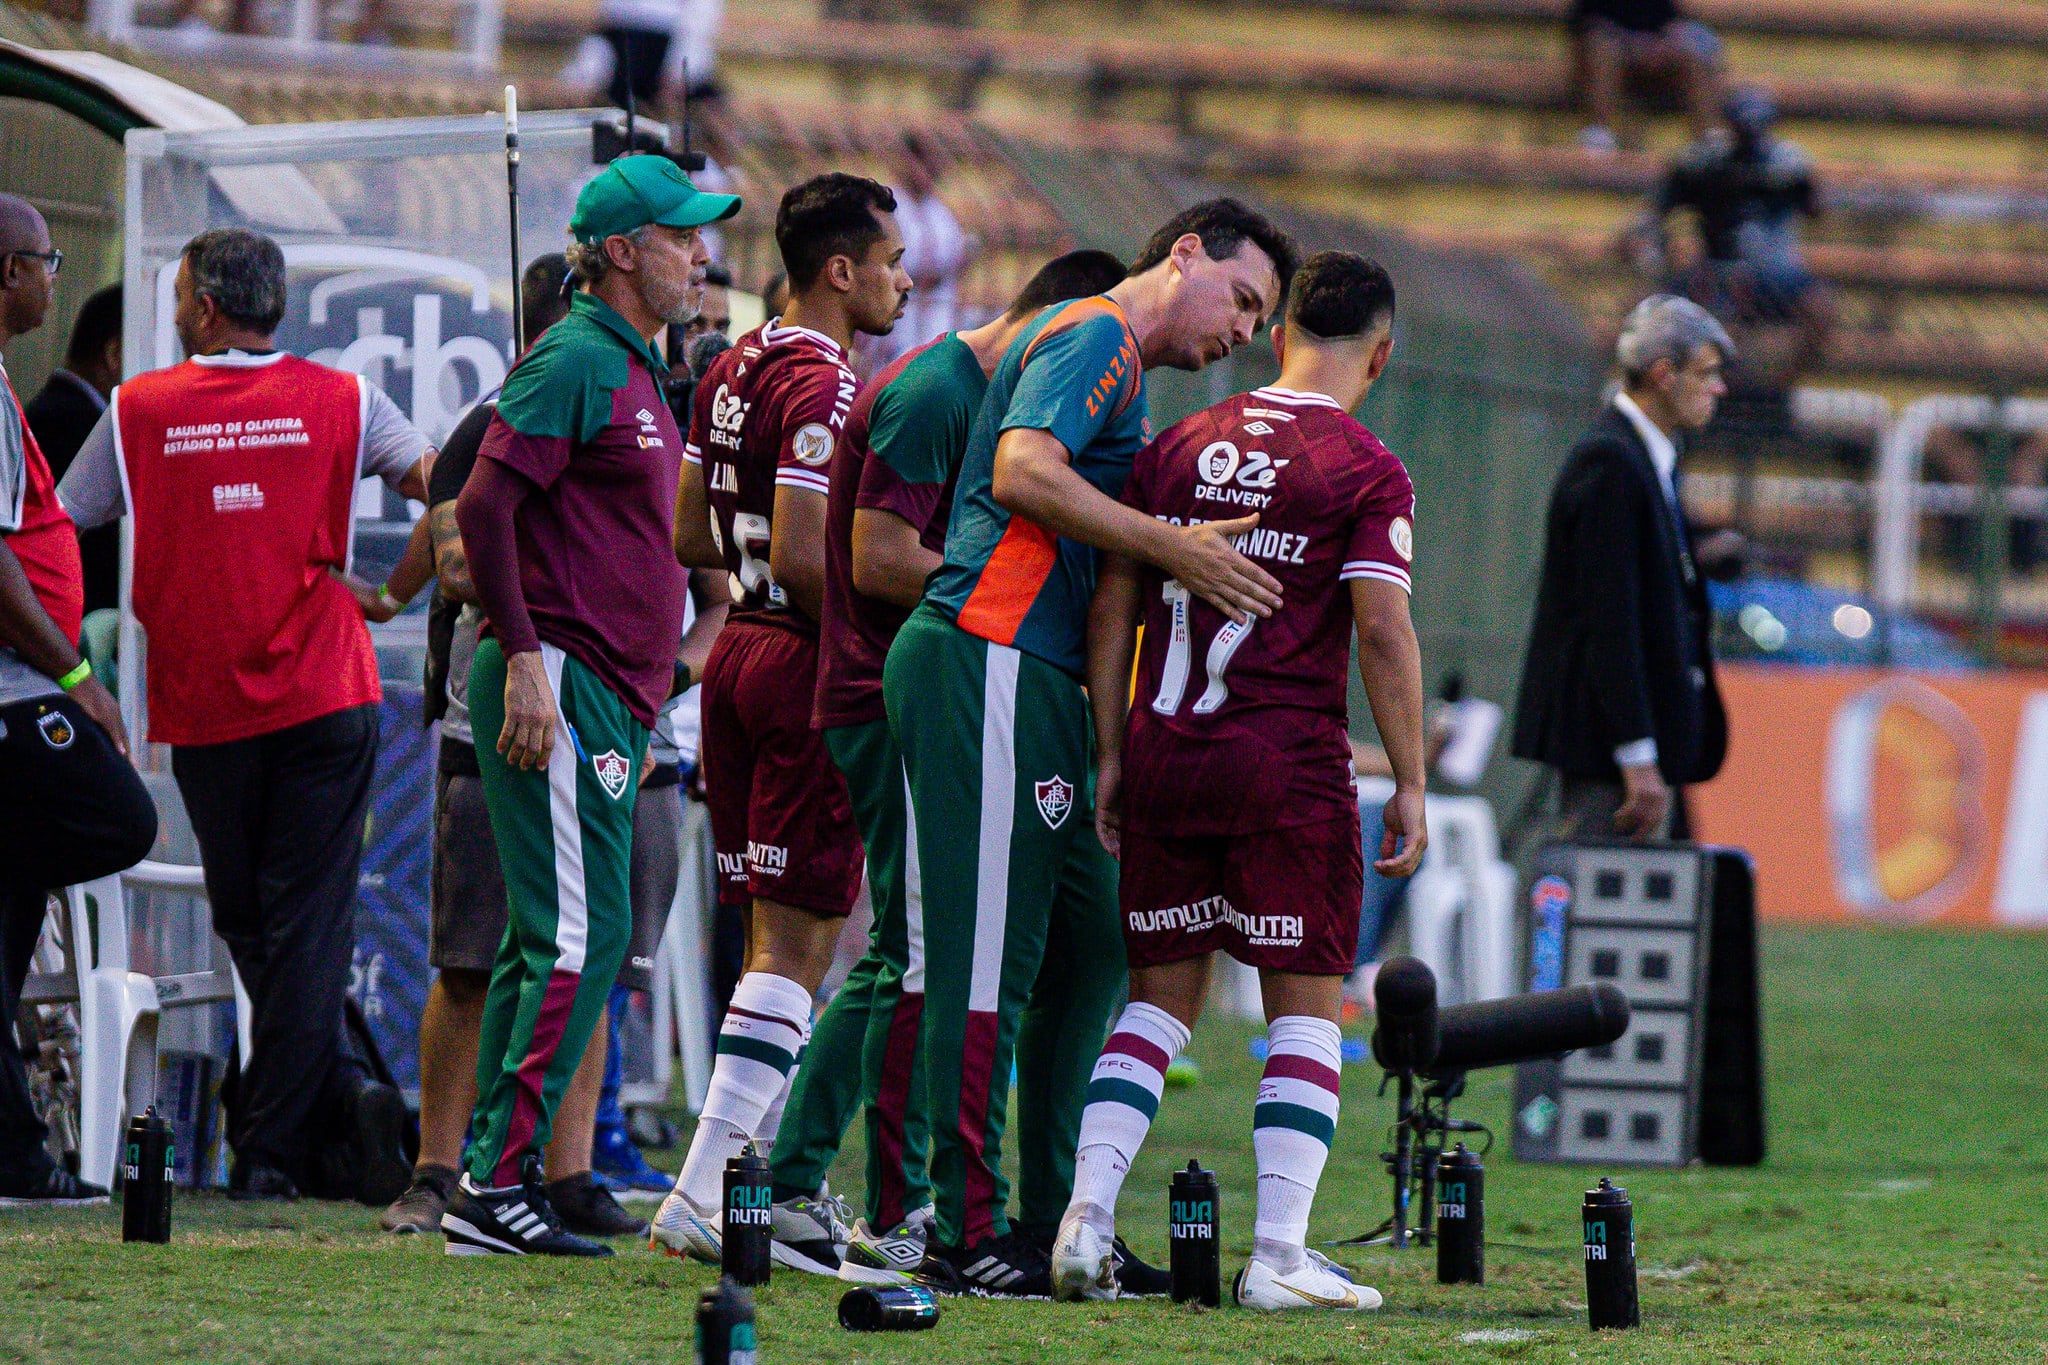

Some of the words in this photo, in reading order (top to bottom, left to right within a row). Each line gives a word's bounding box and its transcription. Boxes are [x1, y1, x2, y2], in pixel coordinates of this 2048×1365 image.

[166, 423, 223, 439] RAULINO
[225, 421, 242, 434] DE
[245, 417, 303, 432] OLIVEIRA
[216, 436, 236, 449] DA
[238, 432, 309, 448] CIDADANIA
[212, 482, 264, 499] SMEL
[1194, 484, 1272, 508] DELIVERY
[1175, 601, 1184, 626] TIM
[1249, 937, 1303, 948] RECOVERY
[1098, 1060, 1133, 1071] FFC
[729, 1208, 771, 1225] NUTRI
[1170, 1223, 1212, 1239] NUTRI
